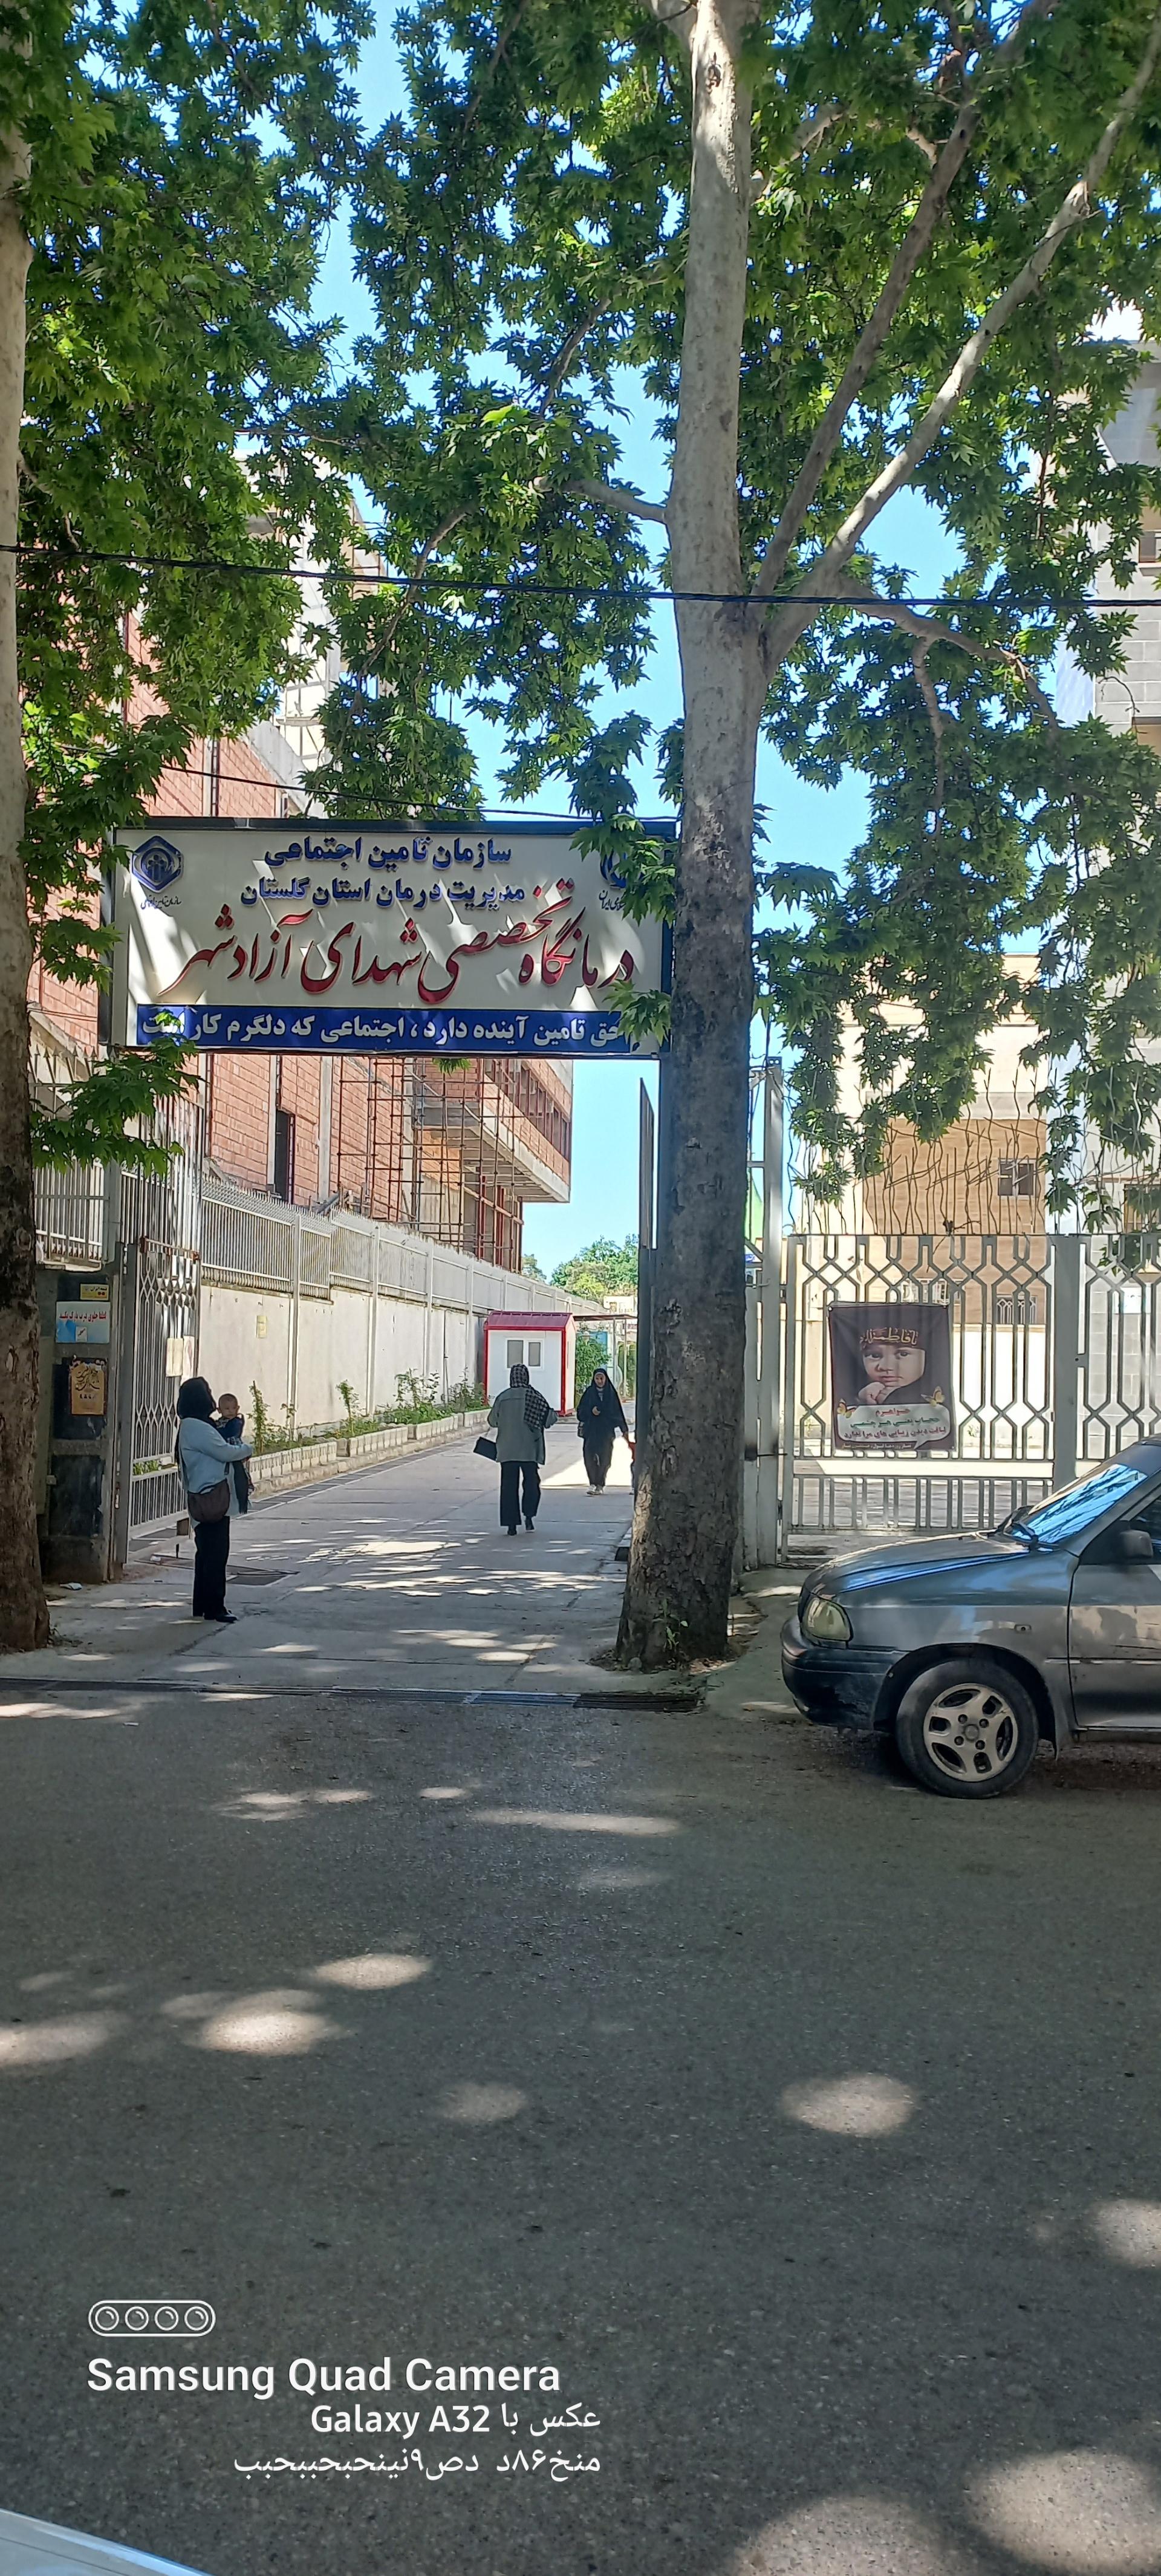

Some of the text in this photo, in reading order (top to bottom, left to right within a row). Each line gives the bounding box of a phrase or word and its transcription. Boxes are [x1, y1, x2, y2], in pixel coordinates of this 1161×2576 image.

[265, 837, 362, 871] اجتماعی
[432, 837, 512, 870] سازمان
[241, 876, 525, 911] مدیریت درمان استان گلستان
[417, 877, 576, 1004] تخصصی
[518, 906, 635, 989] درمانگاه
[301, 917, 422, 995] شهدای
[189, 1012, 222, 1041] کار
[227, 1013, 286, 1042] دلگرم
[290, 1015, 316, 1036] که
[320, 1016, 404, 1044] اجتماعی
[423, 1016, 467, 1046] دارد
[473, 1015, 529, 1045] آینده
[533, 1018, 585, 1047] تامین
